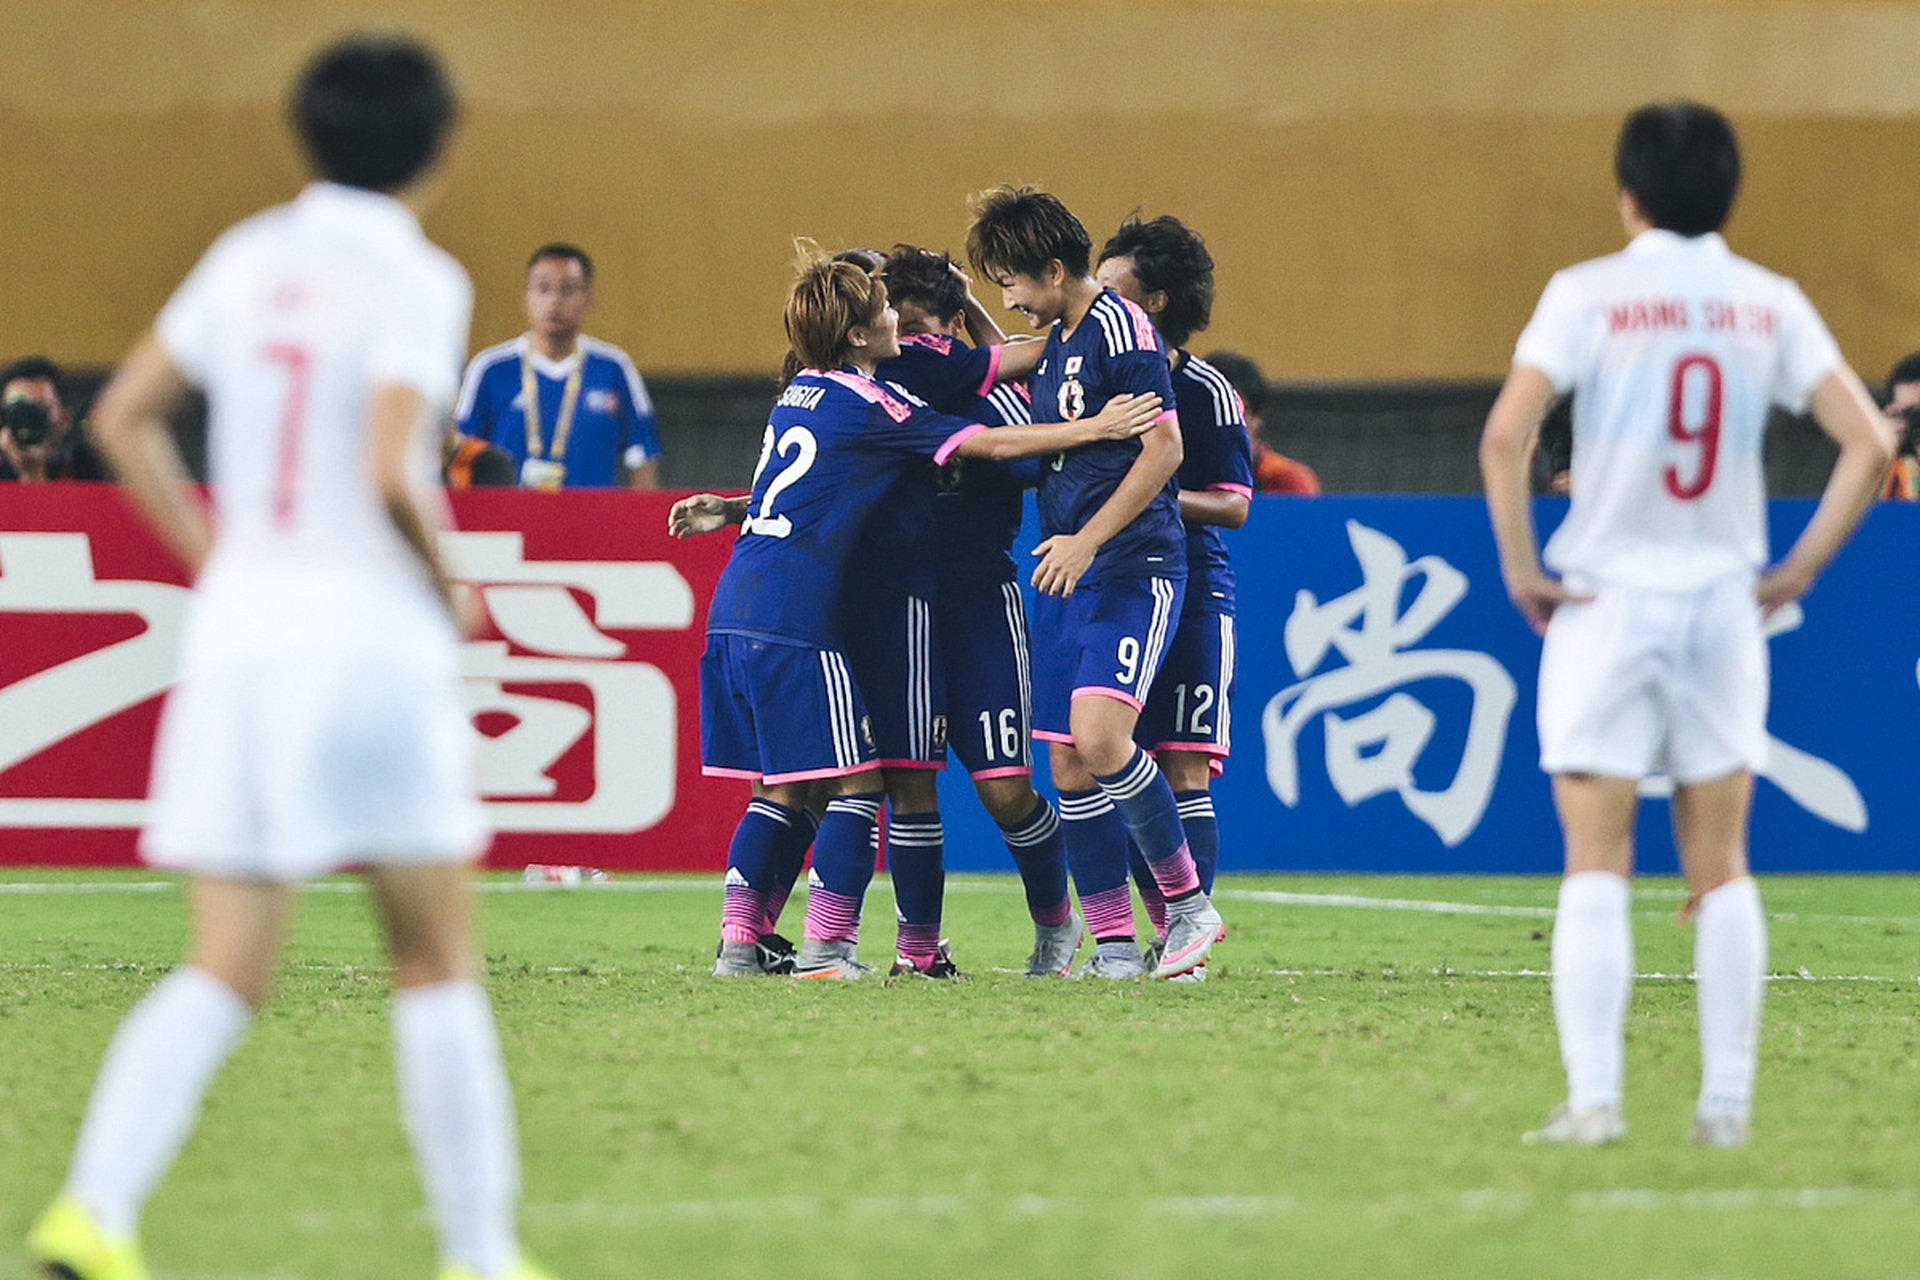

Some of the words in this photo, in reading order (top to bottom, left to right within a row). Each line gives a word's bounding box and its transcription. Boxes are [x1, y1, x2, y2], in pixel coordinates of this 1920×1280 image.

[776, 384, 826, 411] SUGITA
[262, 342, 312, 530] 7
[1664, 351, 1722, 500] 9
[1115, 636, 1140, 685] 9
[978, 708, 1019, 761] 16
[1173, 683, 1214, 735] 12
